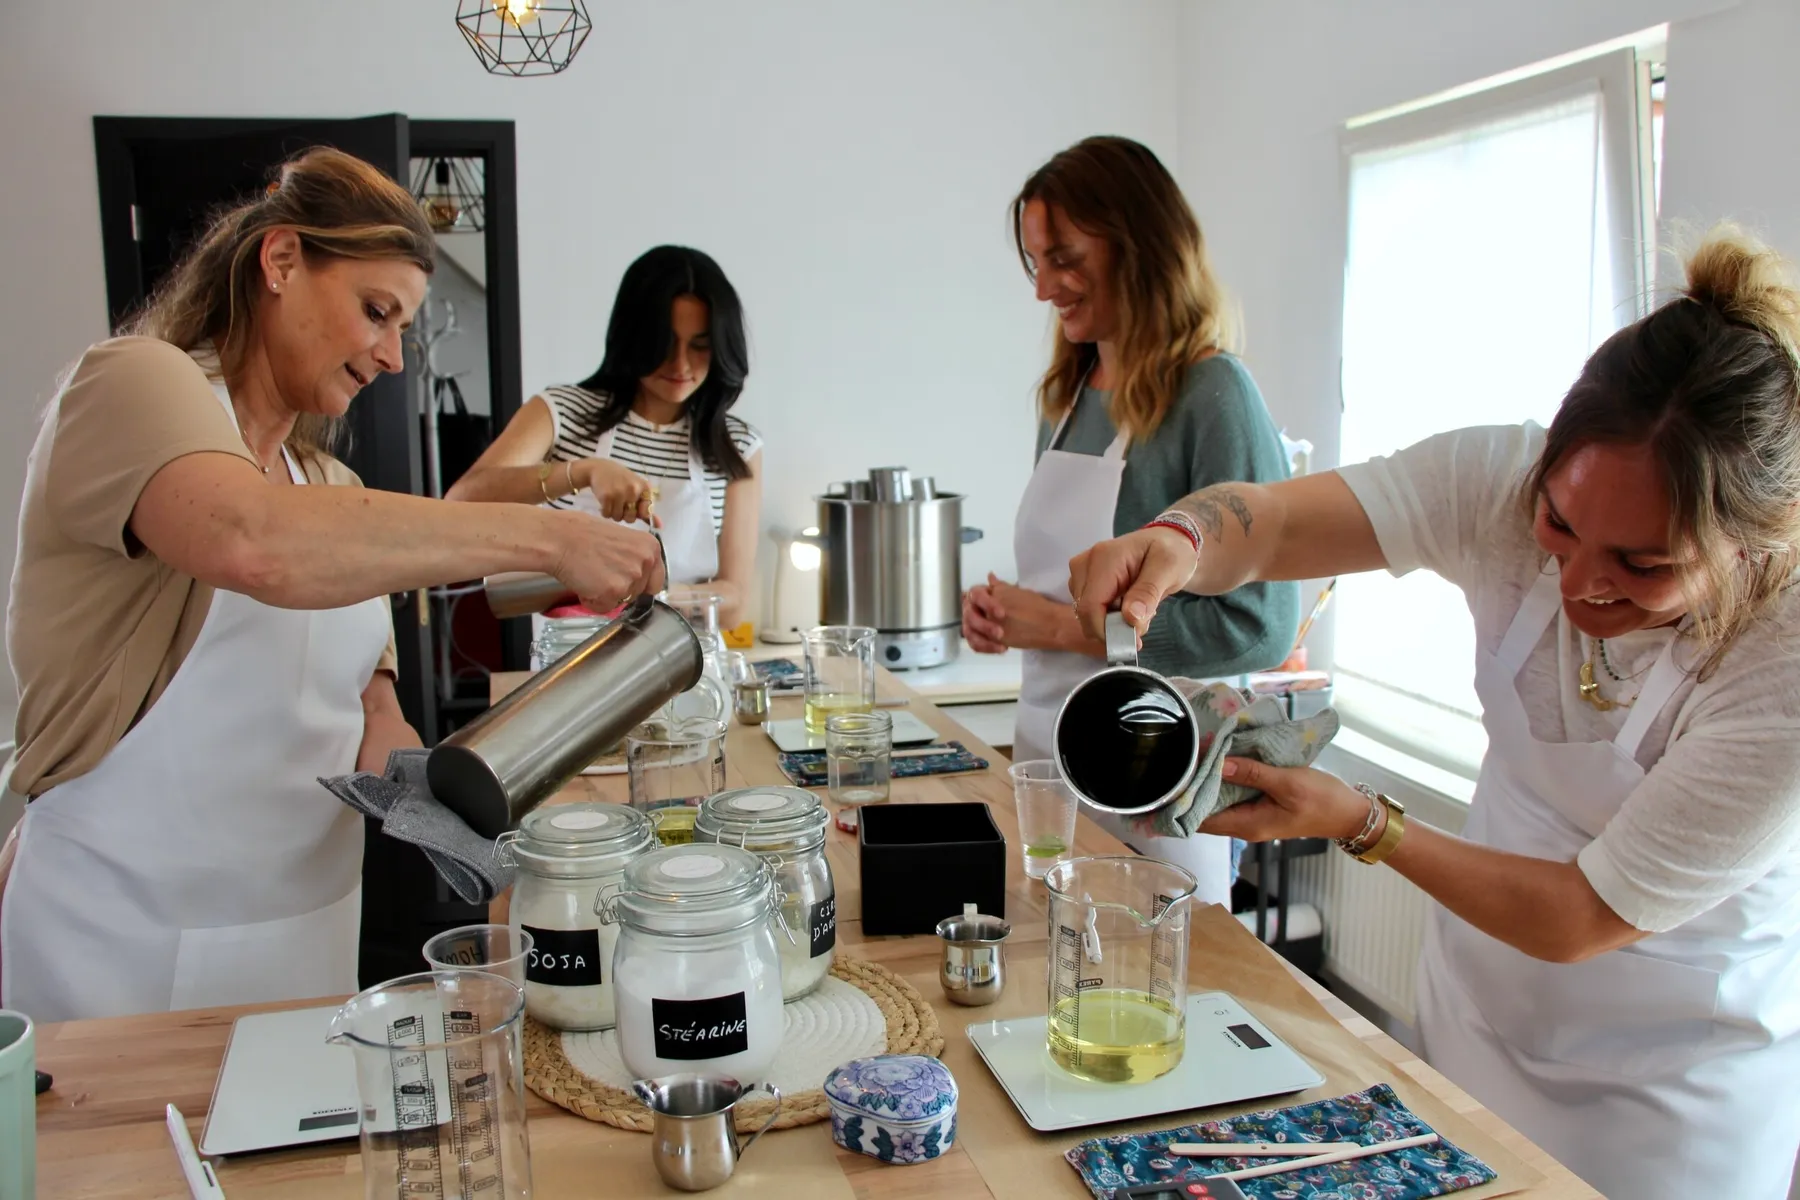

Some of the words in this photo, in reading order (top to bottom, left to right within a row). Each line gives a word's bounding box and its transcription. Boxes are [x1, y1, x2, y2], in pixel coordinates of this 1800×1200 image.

[820, 900, 836, 917] CIR
[530, 948, 586, 969] SOJA
[659, 1019, 746, 1042] STÉARINE
